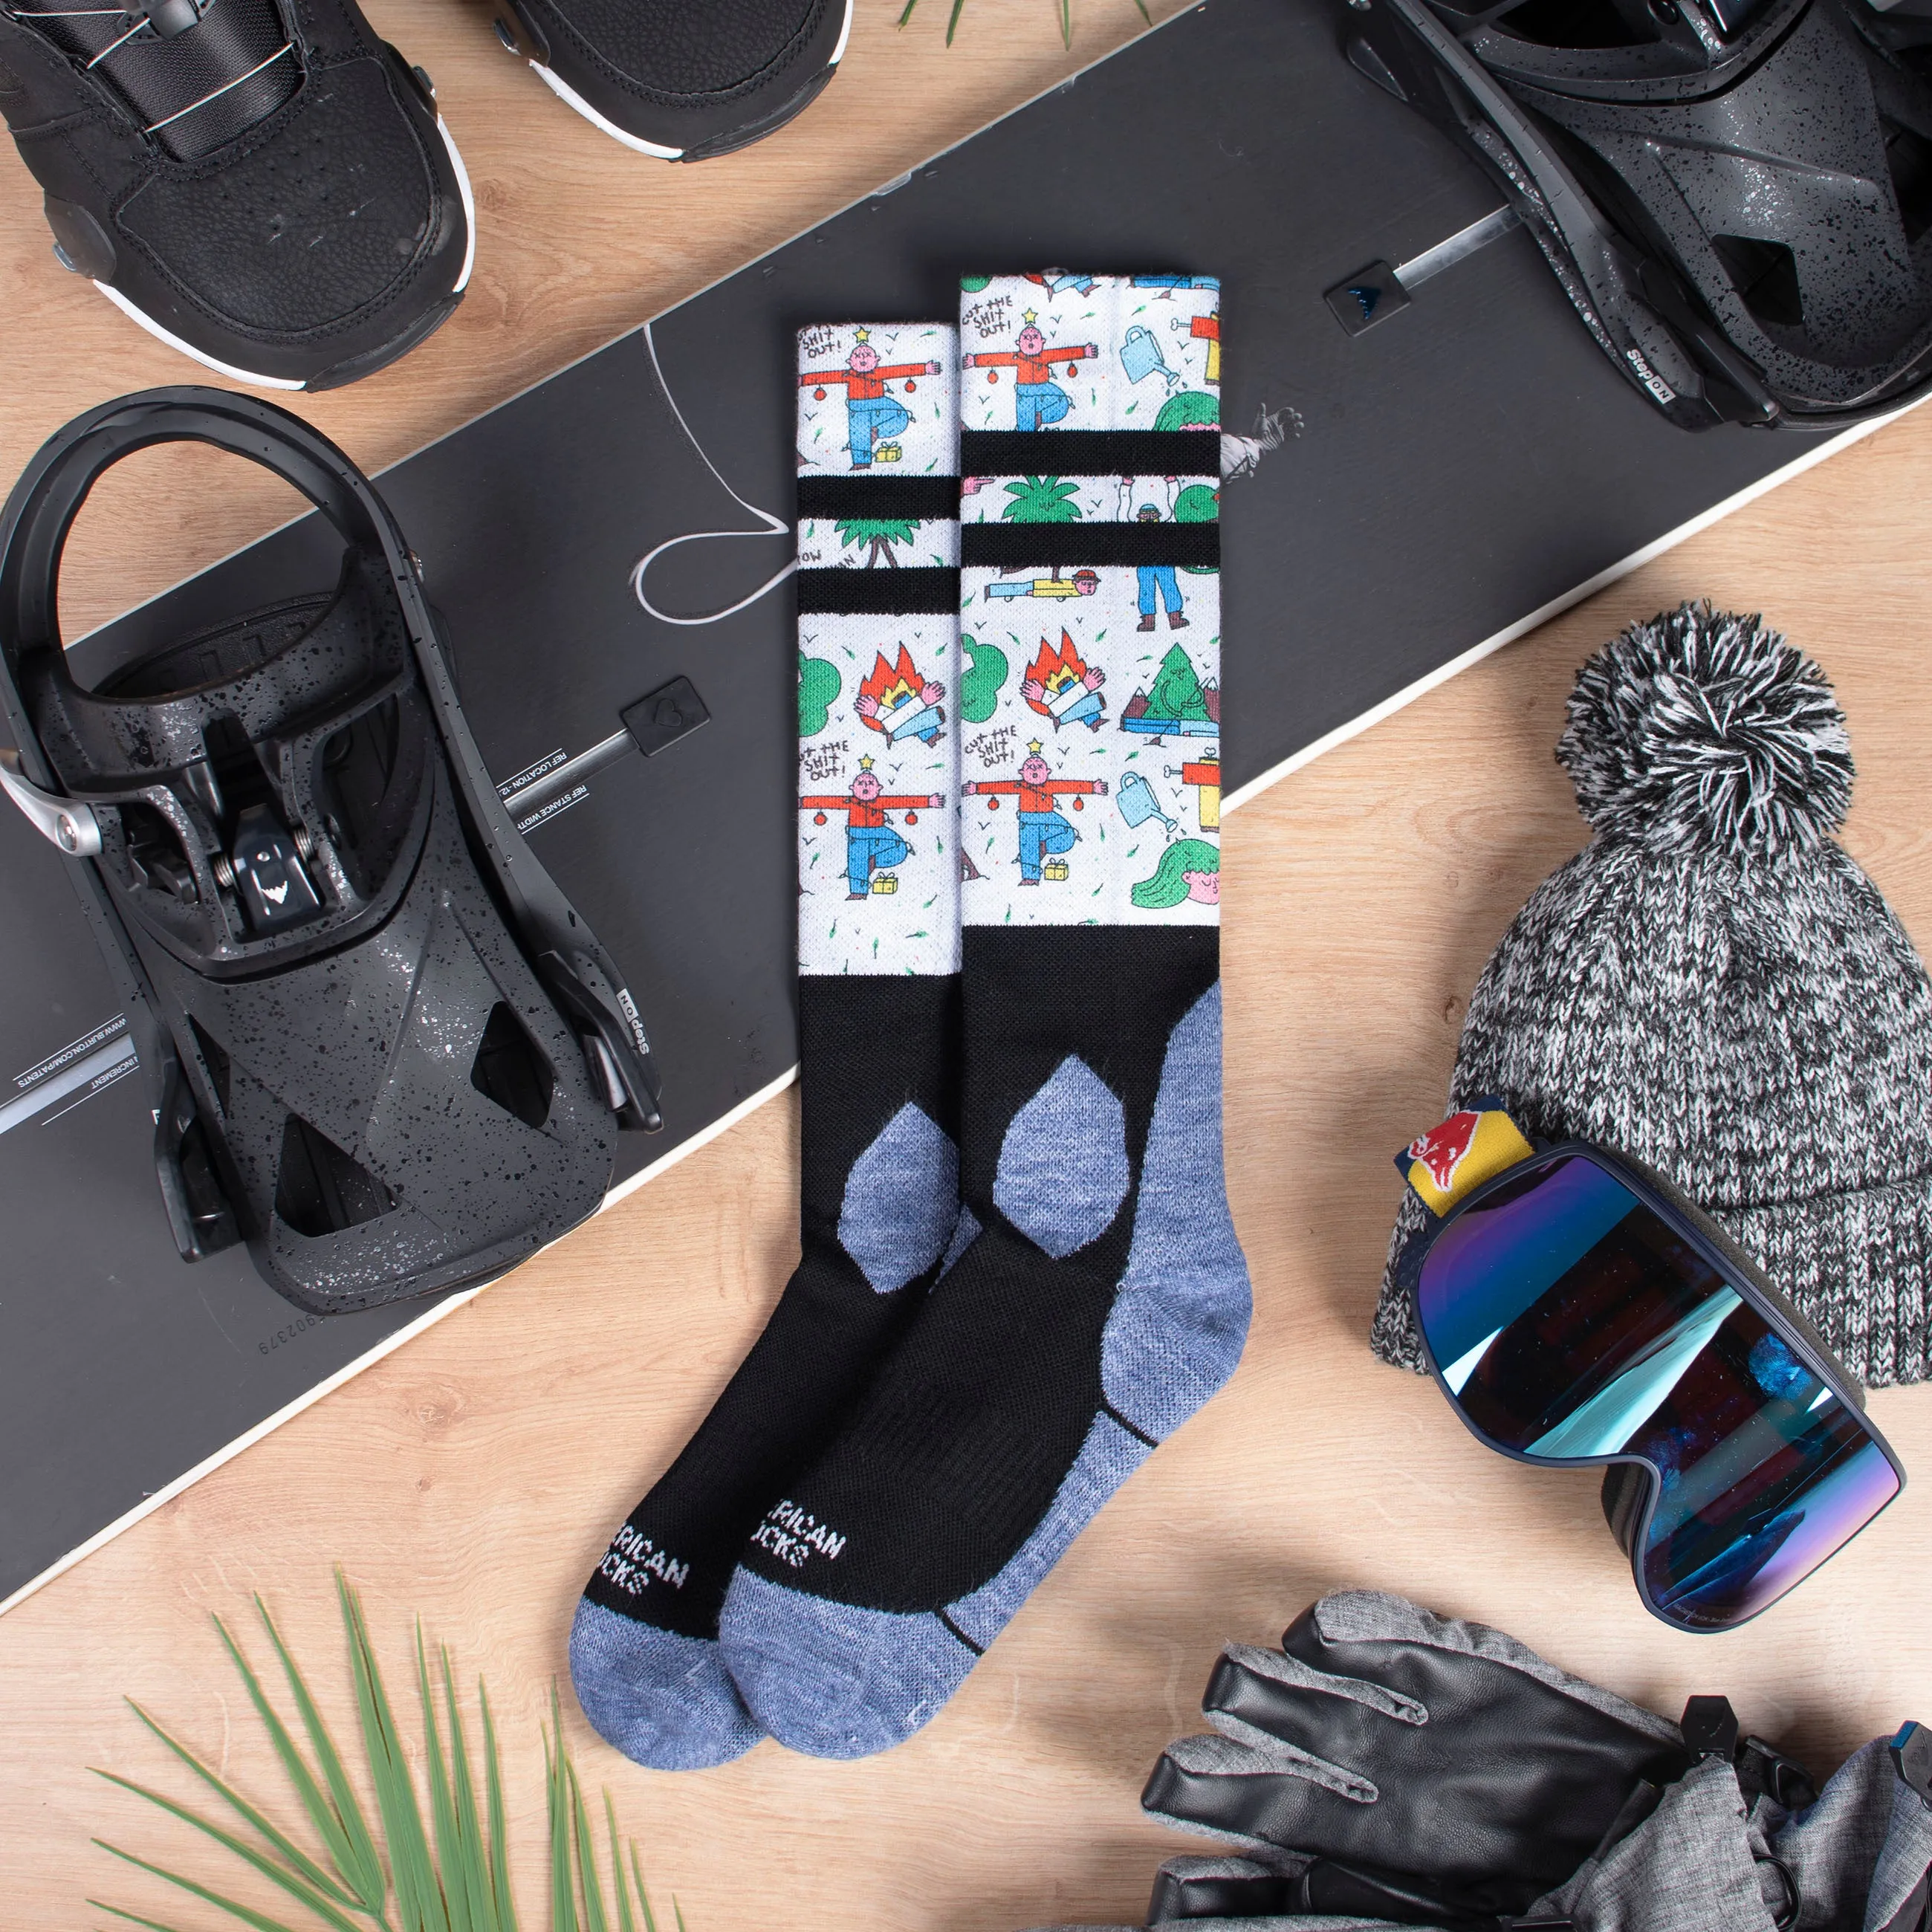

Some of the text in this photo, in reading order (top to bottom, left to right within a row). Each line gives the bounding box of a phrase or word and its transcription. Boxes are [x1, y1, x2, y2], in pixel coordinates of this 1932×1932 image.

[552, 752, 567, 764] REF
[513, 762, 553, 789] LOCATION
[571, 785, 587, 798] REF
[541, 794, 572, 817] STANCE
[91, 1060, 136, 1089] INCREMENT
[259, 1315, 325, 1355] 902379
